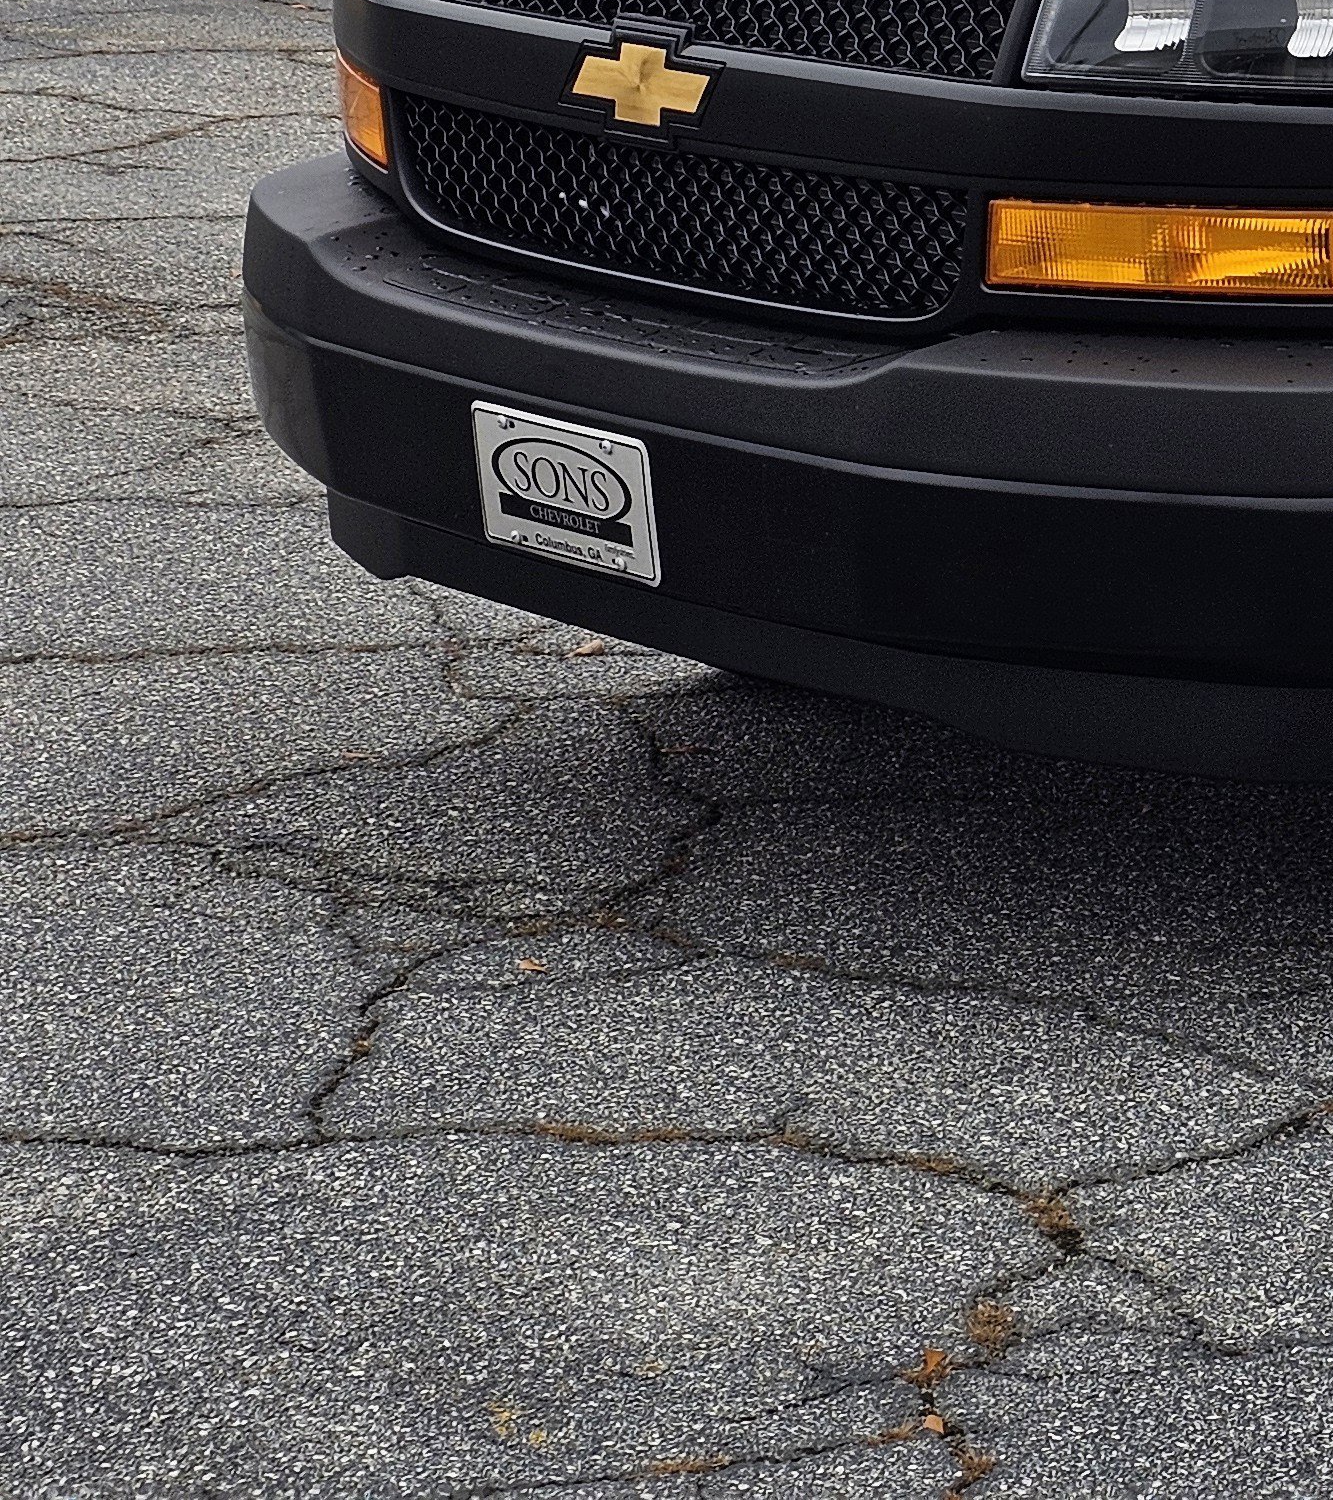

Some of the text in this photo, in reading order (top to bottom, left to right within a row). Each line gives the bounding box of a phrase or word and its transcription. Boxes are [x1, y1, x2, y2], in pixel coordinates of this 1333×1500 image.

[513, 451, 610, 512] SONS
[529, 504, 600, 534] CHEVROLET
[535, 532, 587, 558] Columbus,
[587, 546, 604, 562] GA
